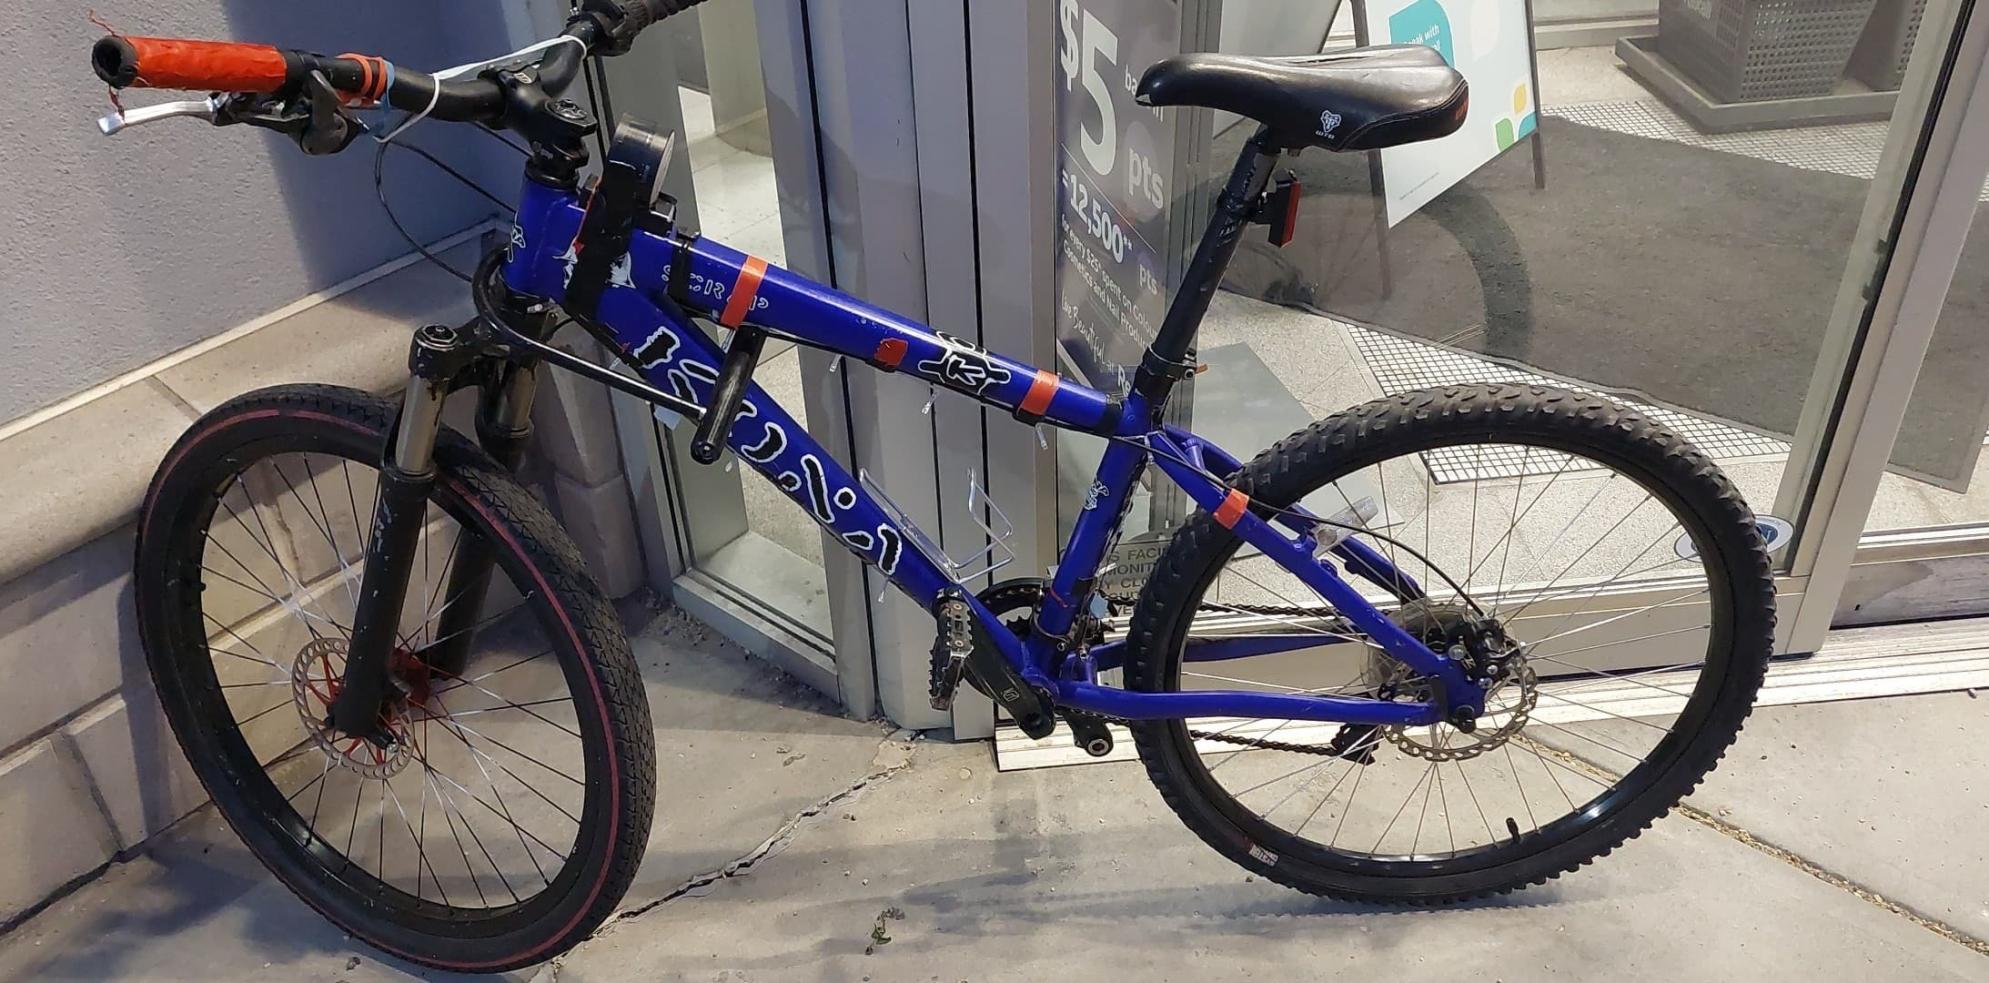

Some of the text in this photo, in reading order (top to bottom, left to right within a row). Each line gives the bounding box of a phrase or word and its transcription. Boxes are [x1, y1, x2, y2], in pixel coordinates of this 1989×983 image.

[1128, 146, 1164, 209] pts
[1063, 239, 1093, 287] Cosmetics
[1093, 281, 1106, 303] and
[1106, 294, 1120, 321] Nail
[1069, 229, 1086, 259] every
[1102, 270, 1121, 302] spent
[1122, 294, 1133, 313] on
[1139, 263, 1158, 295] pts
